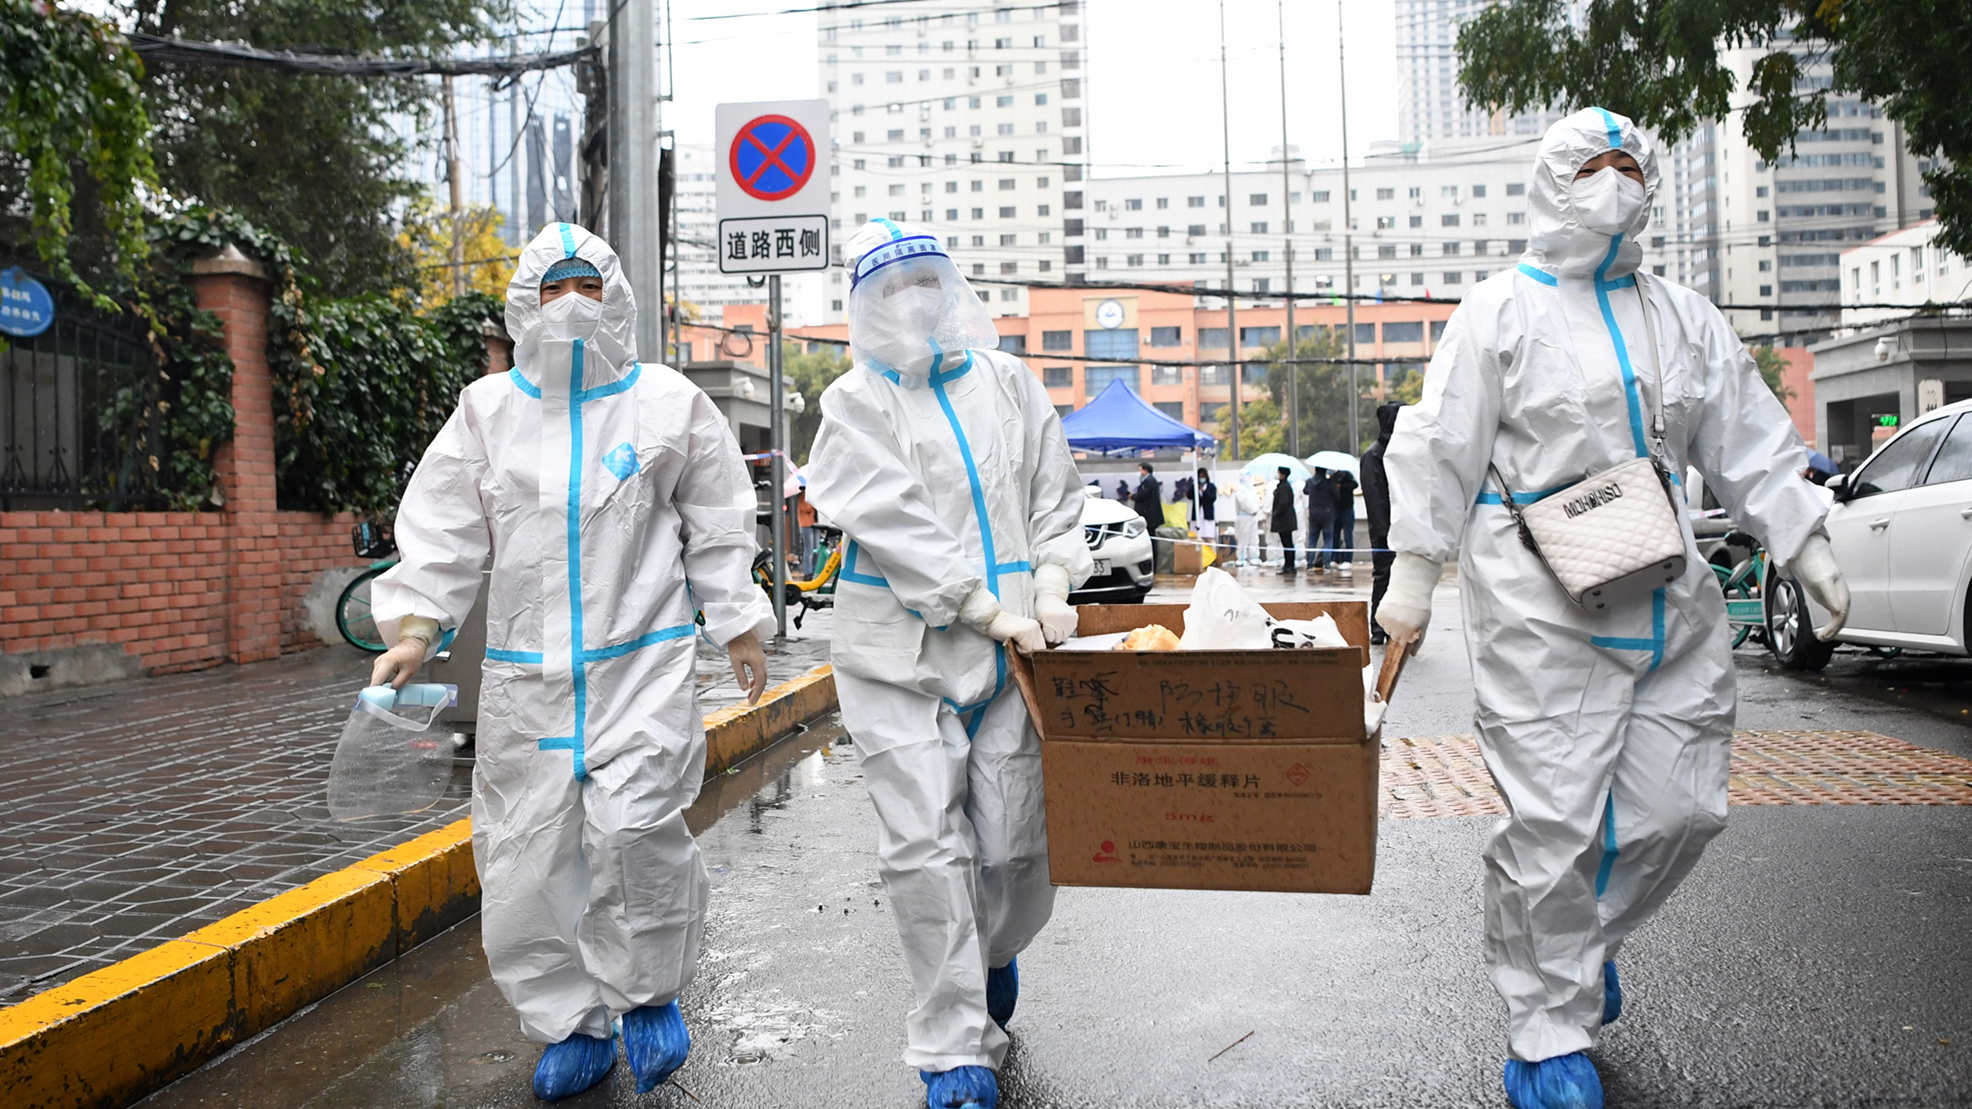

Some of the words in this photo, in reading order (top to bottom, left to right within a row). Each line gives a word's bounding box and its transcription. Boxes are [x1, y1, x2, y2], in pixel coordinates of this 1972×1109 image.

[727, 228, 820, 260] 道路西侧
[1111, 771, 1262, 789] 非洛地平缓释片
